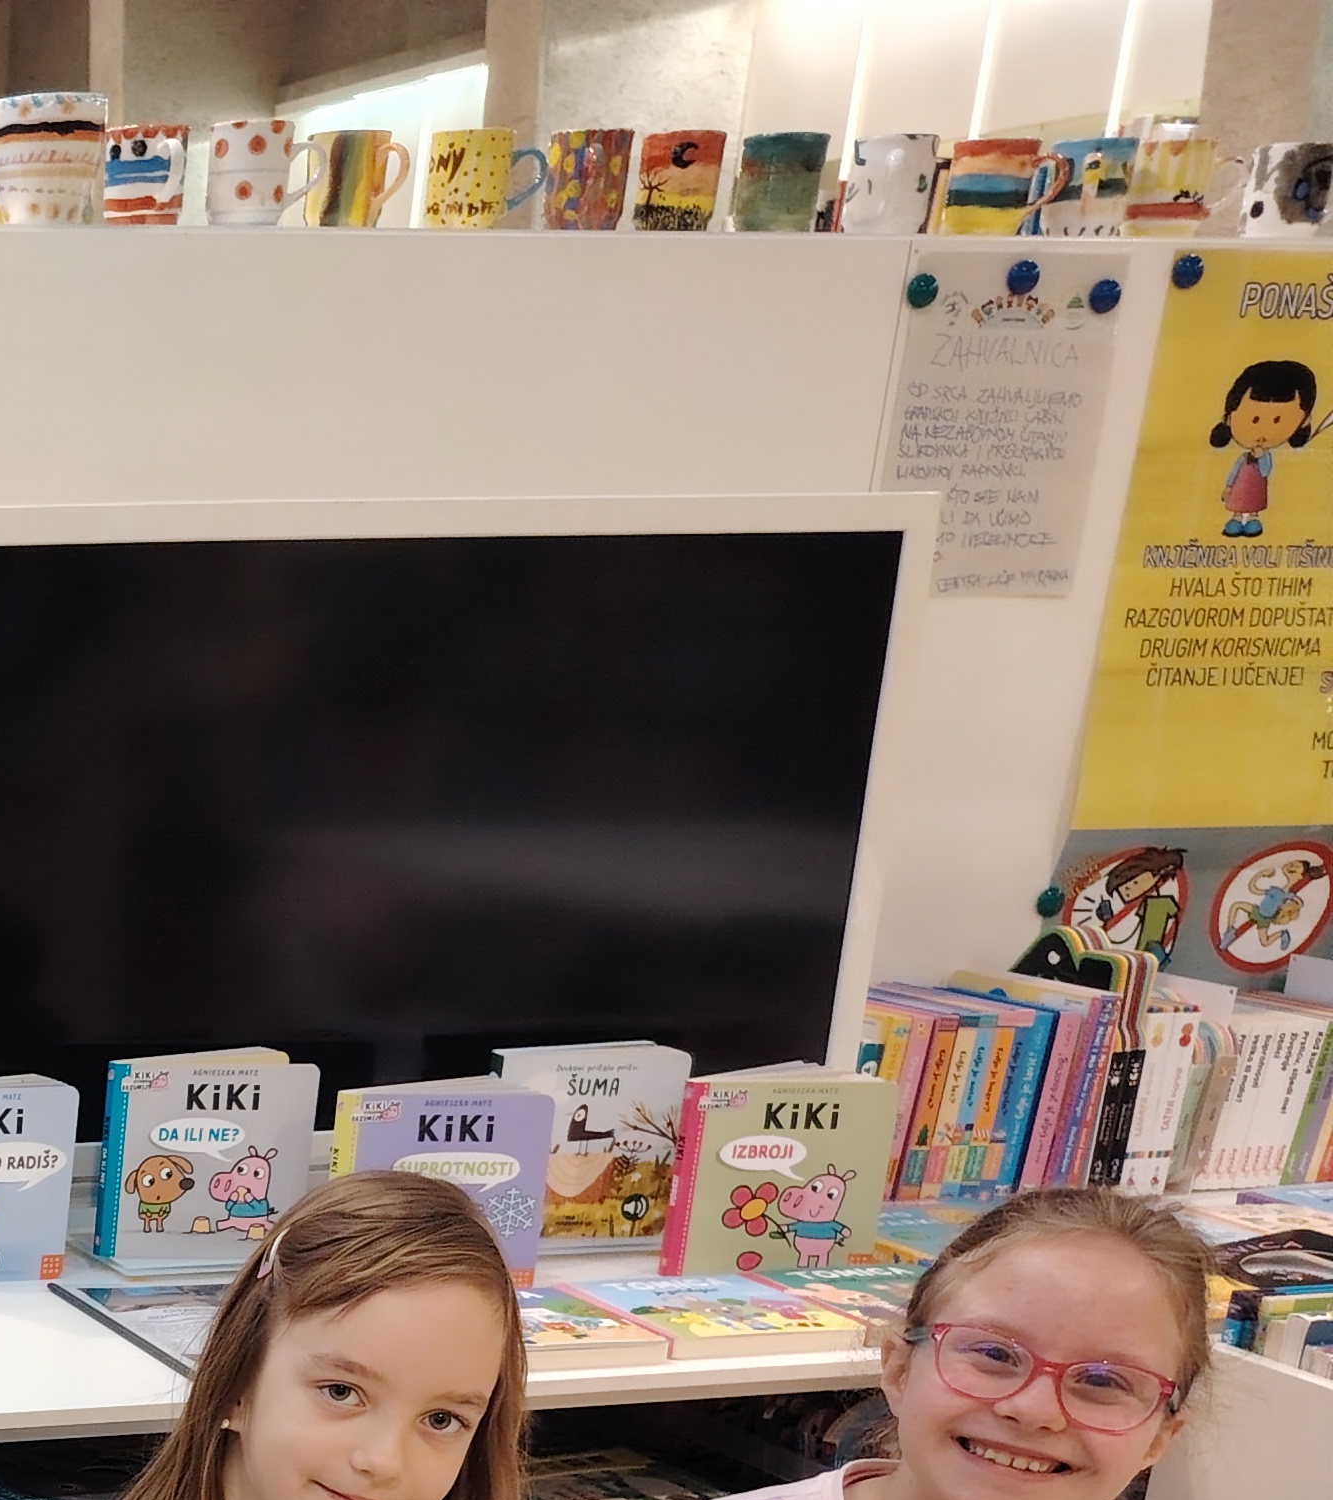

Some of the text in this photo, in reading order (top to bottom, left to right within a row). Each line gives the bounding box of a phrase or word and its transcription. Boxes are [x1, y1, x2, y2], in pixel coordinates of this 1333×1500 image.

[1170, 571, 1312, 597] HVALA ŠTO TIHIM
[1124, 607, 1243, 628] RAZGOVOROM
[1140, 637, 1321, 659] DRUGIM KORISNICIMA
[1146, 661, 1304, 687] ČITANJE I UČENJE!
[566, 1073, 619, 1097] ŠUMA
[159, 1128, 239, 1141] DA ILI NE?
[6, 1148, 59, 1170] RADIŠ?
[732, 1144, 794, 1160] IZBROJI
[399, 1161, 514, 1176] SUPROTNOSTI
[785, 1265, 917, 1282] TOMICA
[602, 1276, 731, 1293] TOMICA
